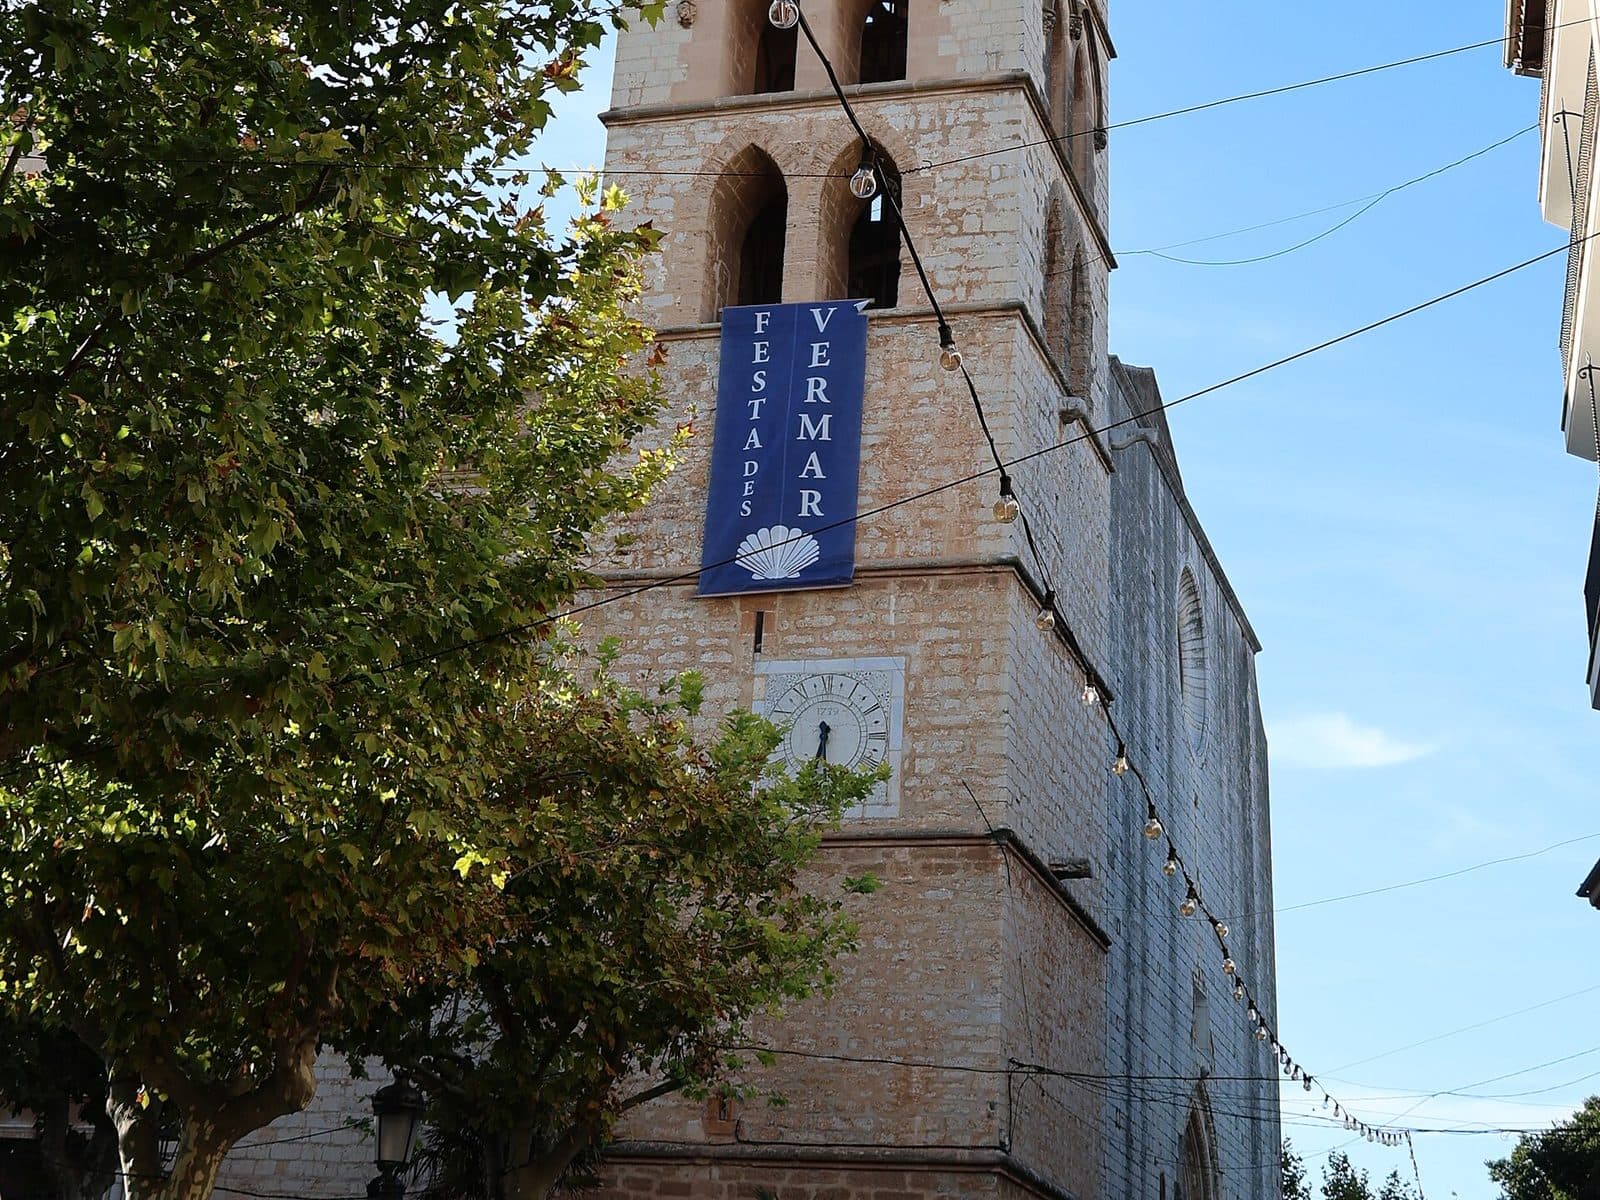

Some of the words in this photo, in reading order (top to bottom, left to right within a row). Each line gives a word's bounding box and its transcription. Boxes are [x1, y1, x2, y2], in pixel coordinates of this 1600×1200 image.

[743, 311, 771, 450] FESTA
[796, 307, 838, 517] VERMAR
[740, 460, 759, 517] DES
